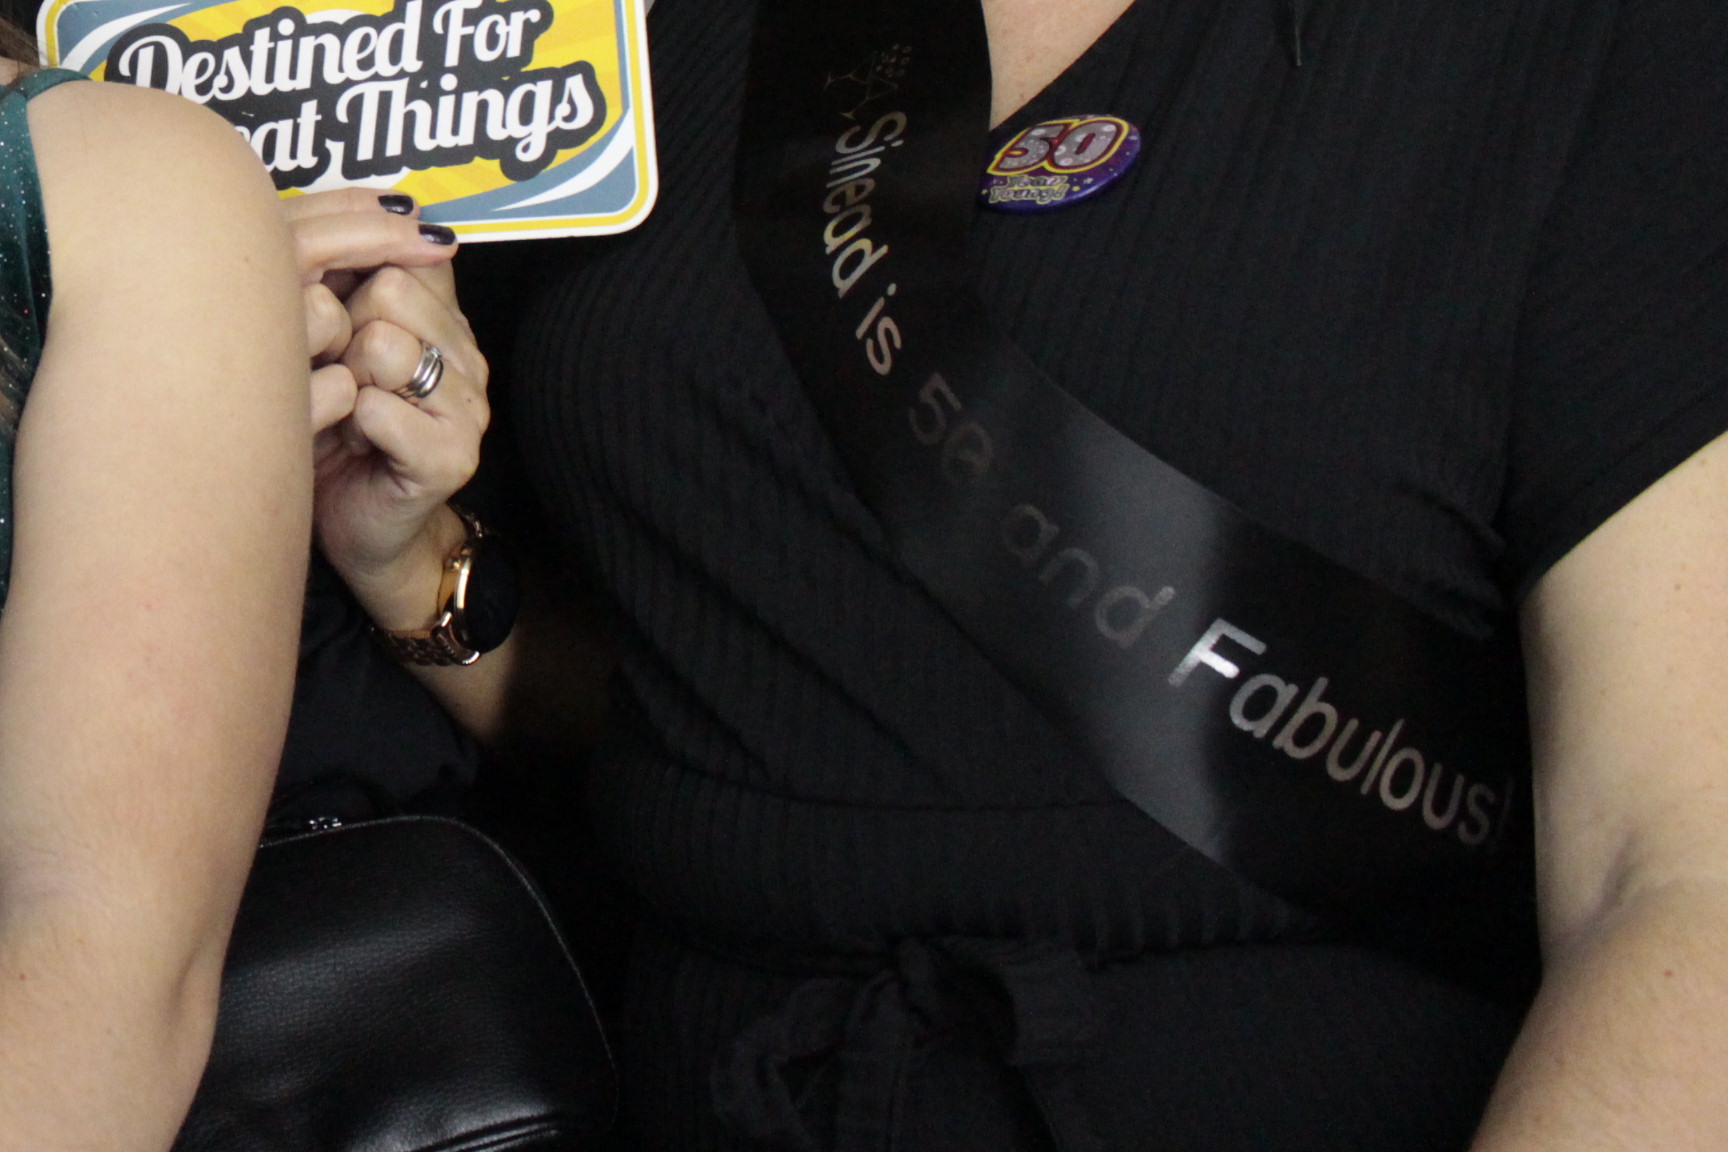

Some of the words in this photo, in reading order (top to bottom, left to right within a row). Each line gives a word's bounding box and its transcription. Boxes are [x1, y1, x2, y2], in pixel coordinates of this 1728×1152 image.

[336, 73, 595, 163] Things
[988, 118, 1127, 173] 50
[821, 112, 907, 299] Sinead
[856, 283, 903, 376] is
[1005, 504, 1177, 649] and
